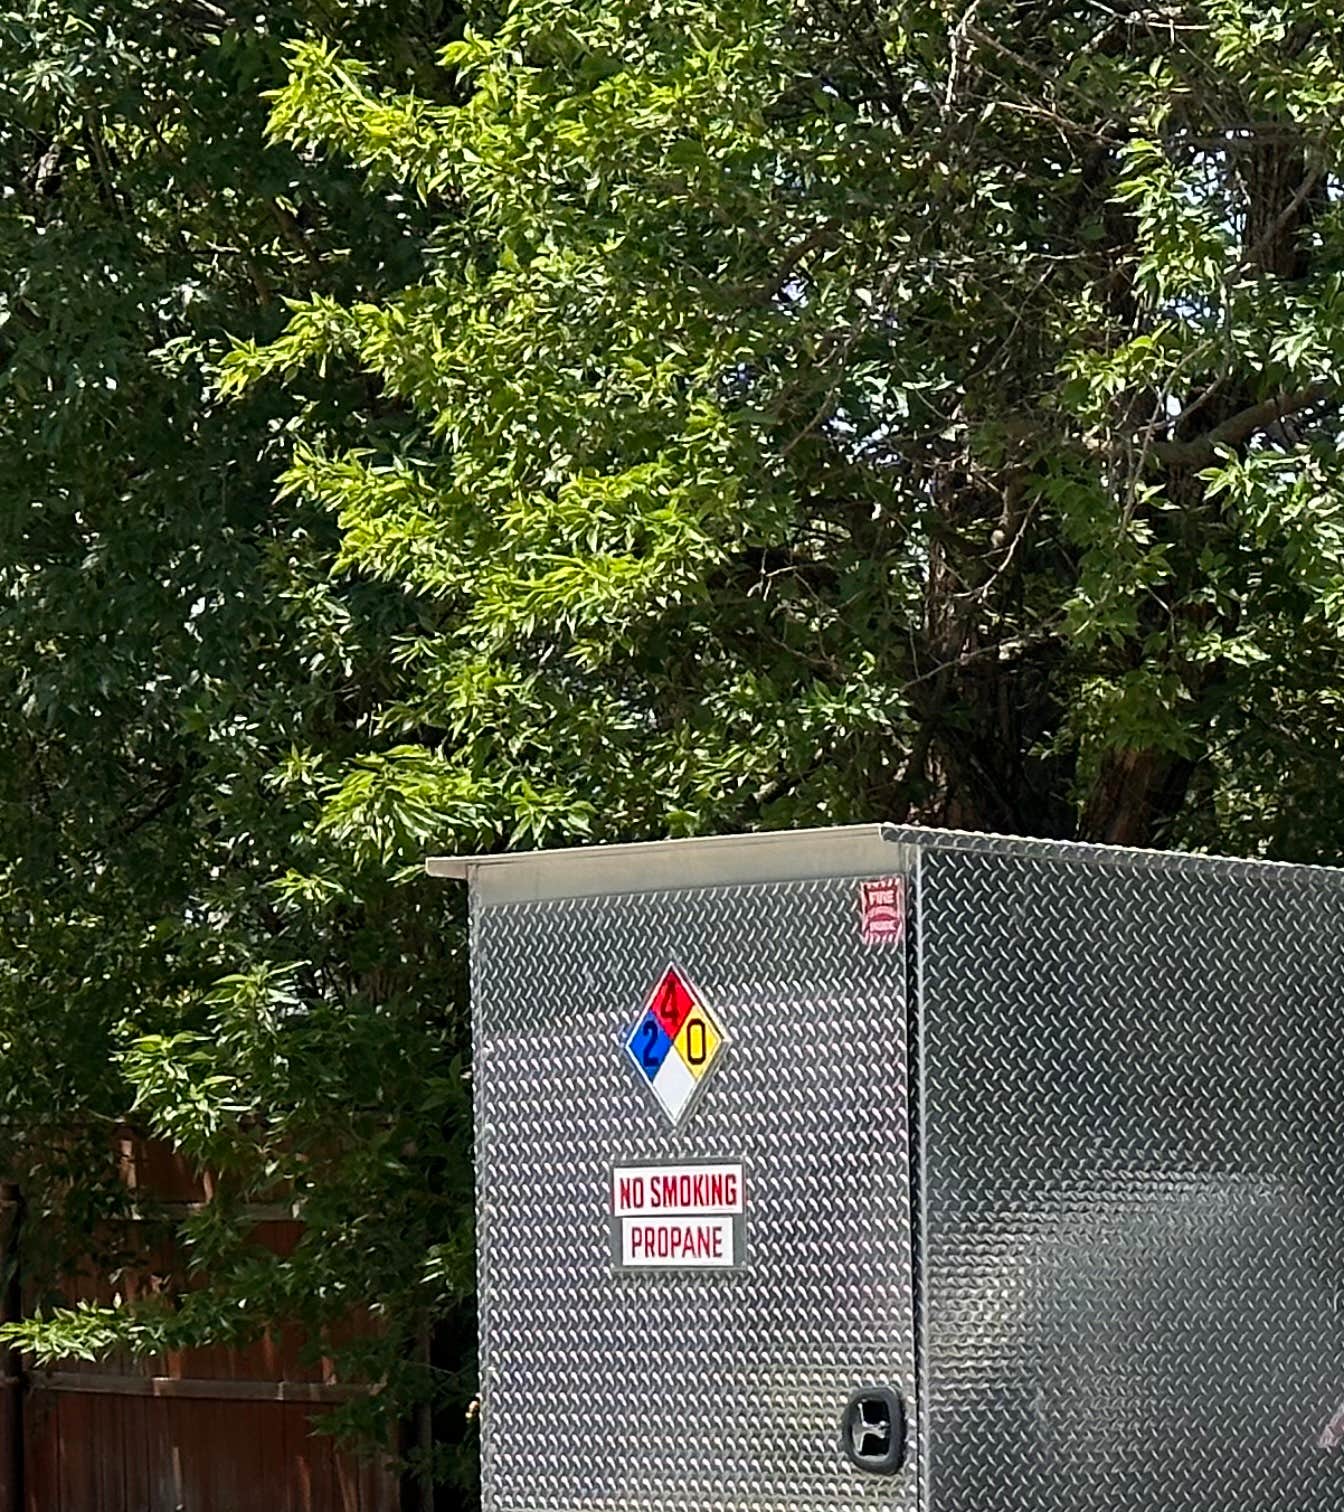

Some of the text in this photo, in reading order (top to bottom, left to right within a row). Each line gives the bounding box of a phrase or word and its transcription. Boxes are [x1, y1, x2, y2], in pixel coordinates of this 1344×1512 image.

[660, 980, 678, 1026] 4
[642, 1018, 705, 1067] 2 0
[620, 1173, 737, 1209] NO SMOKING
[631, 1226, 722, 1258] PROPANE
